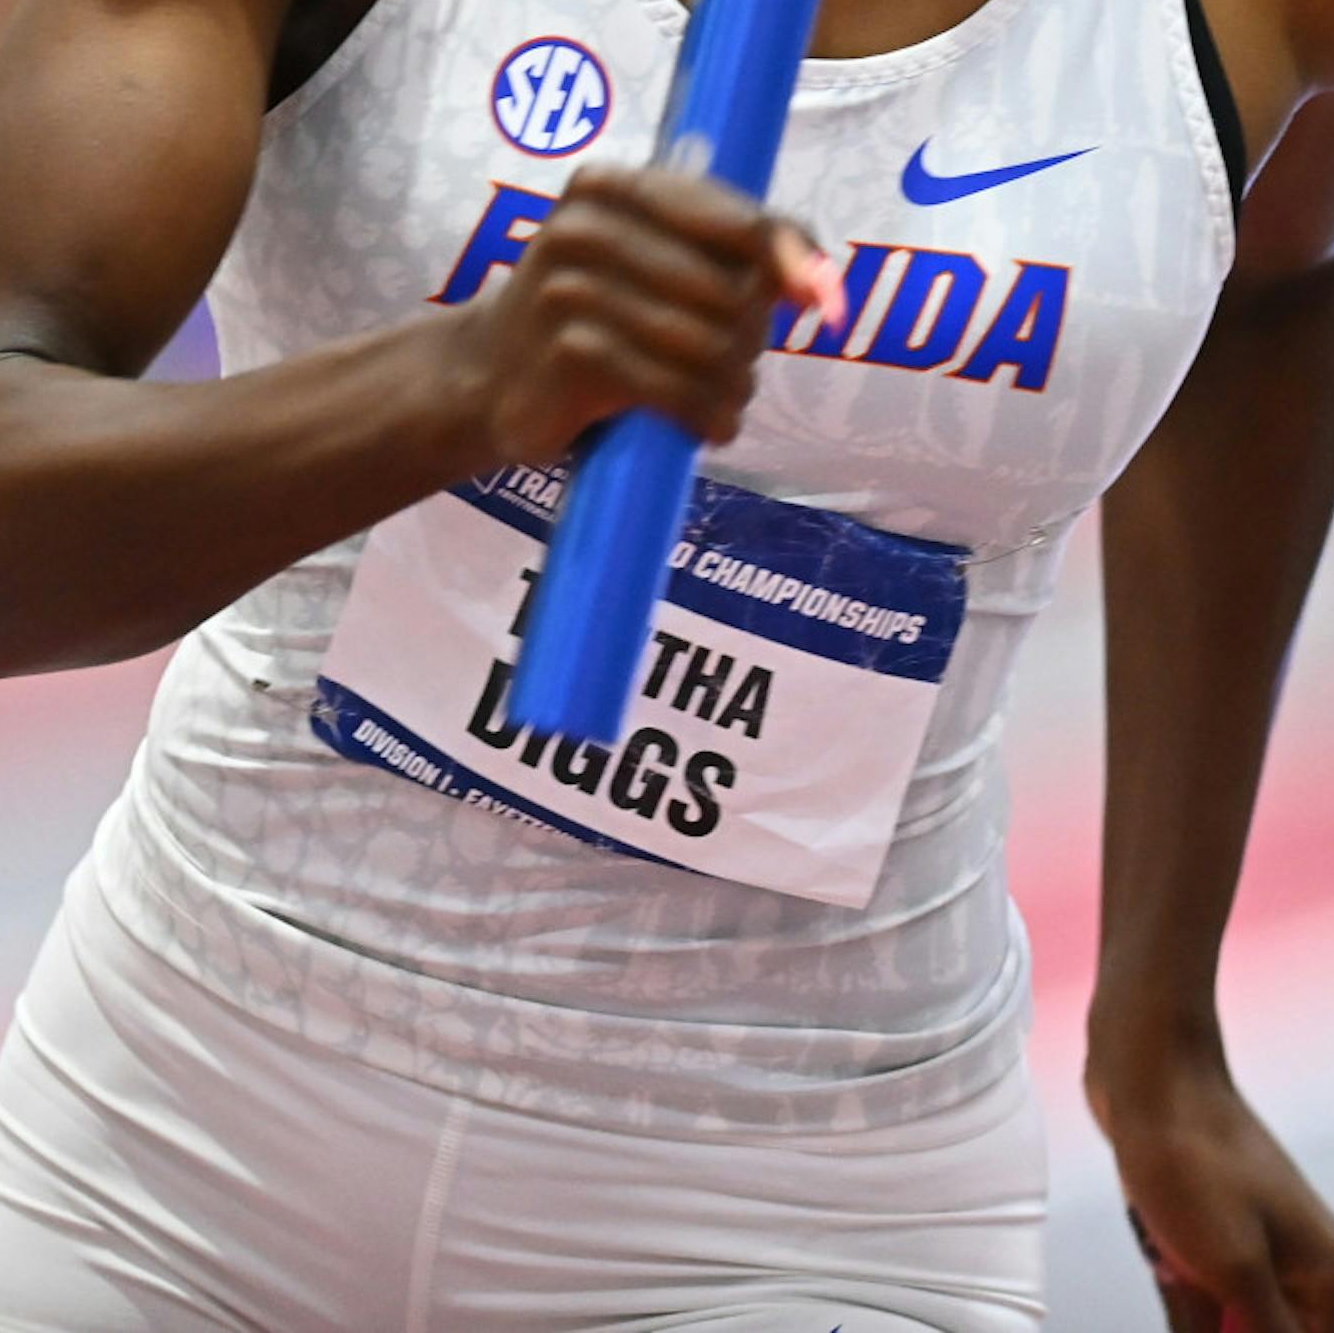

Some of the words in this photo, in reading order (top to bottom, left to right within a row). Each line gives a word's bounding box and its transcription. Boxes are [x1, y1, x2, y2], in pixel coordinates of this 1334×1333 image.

[494, 45, 606, 152] SEC
[425, 180, 1073, 394] FIDA
[692, 550, 927, 645] CHAMPIONSHIPS
[351, 719, 441, 787] DIVISION
